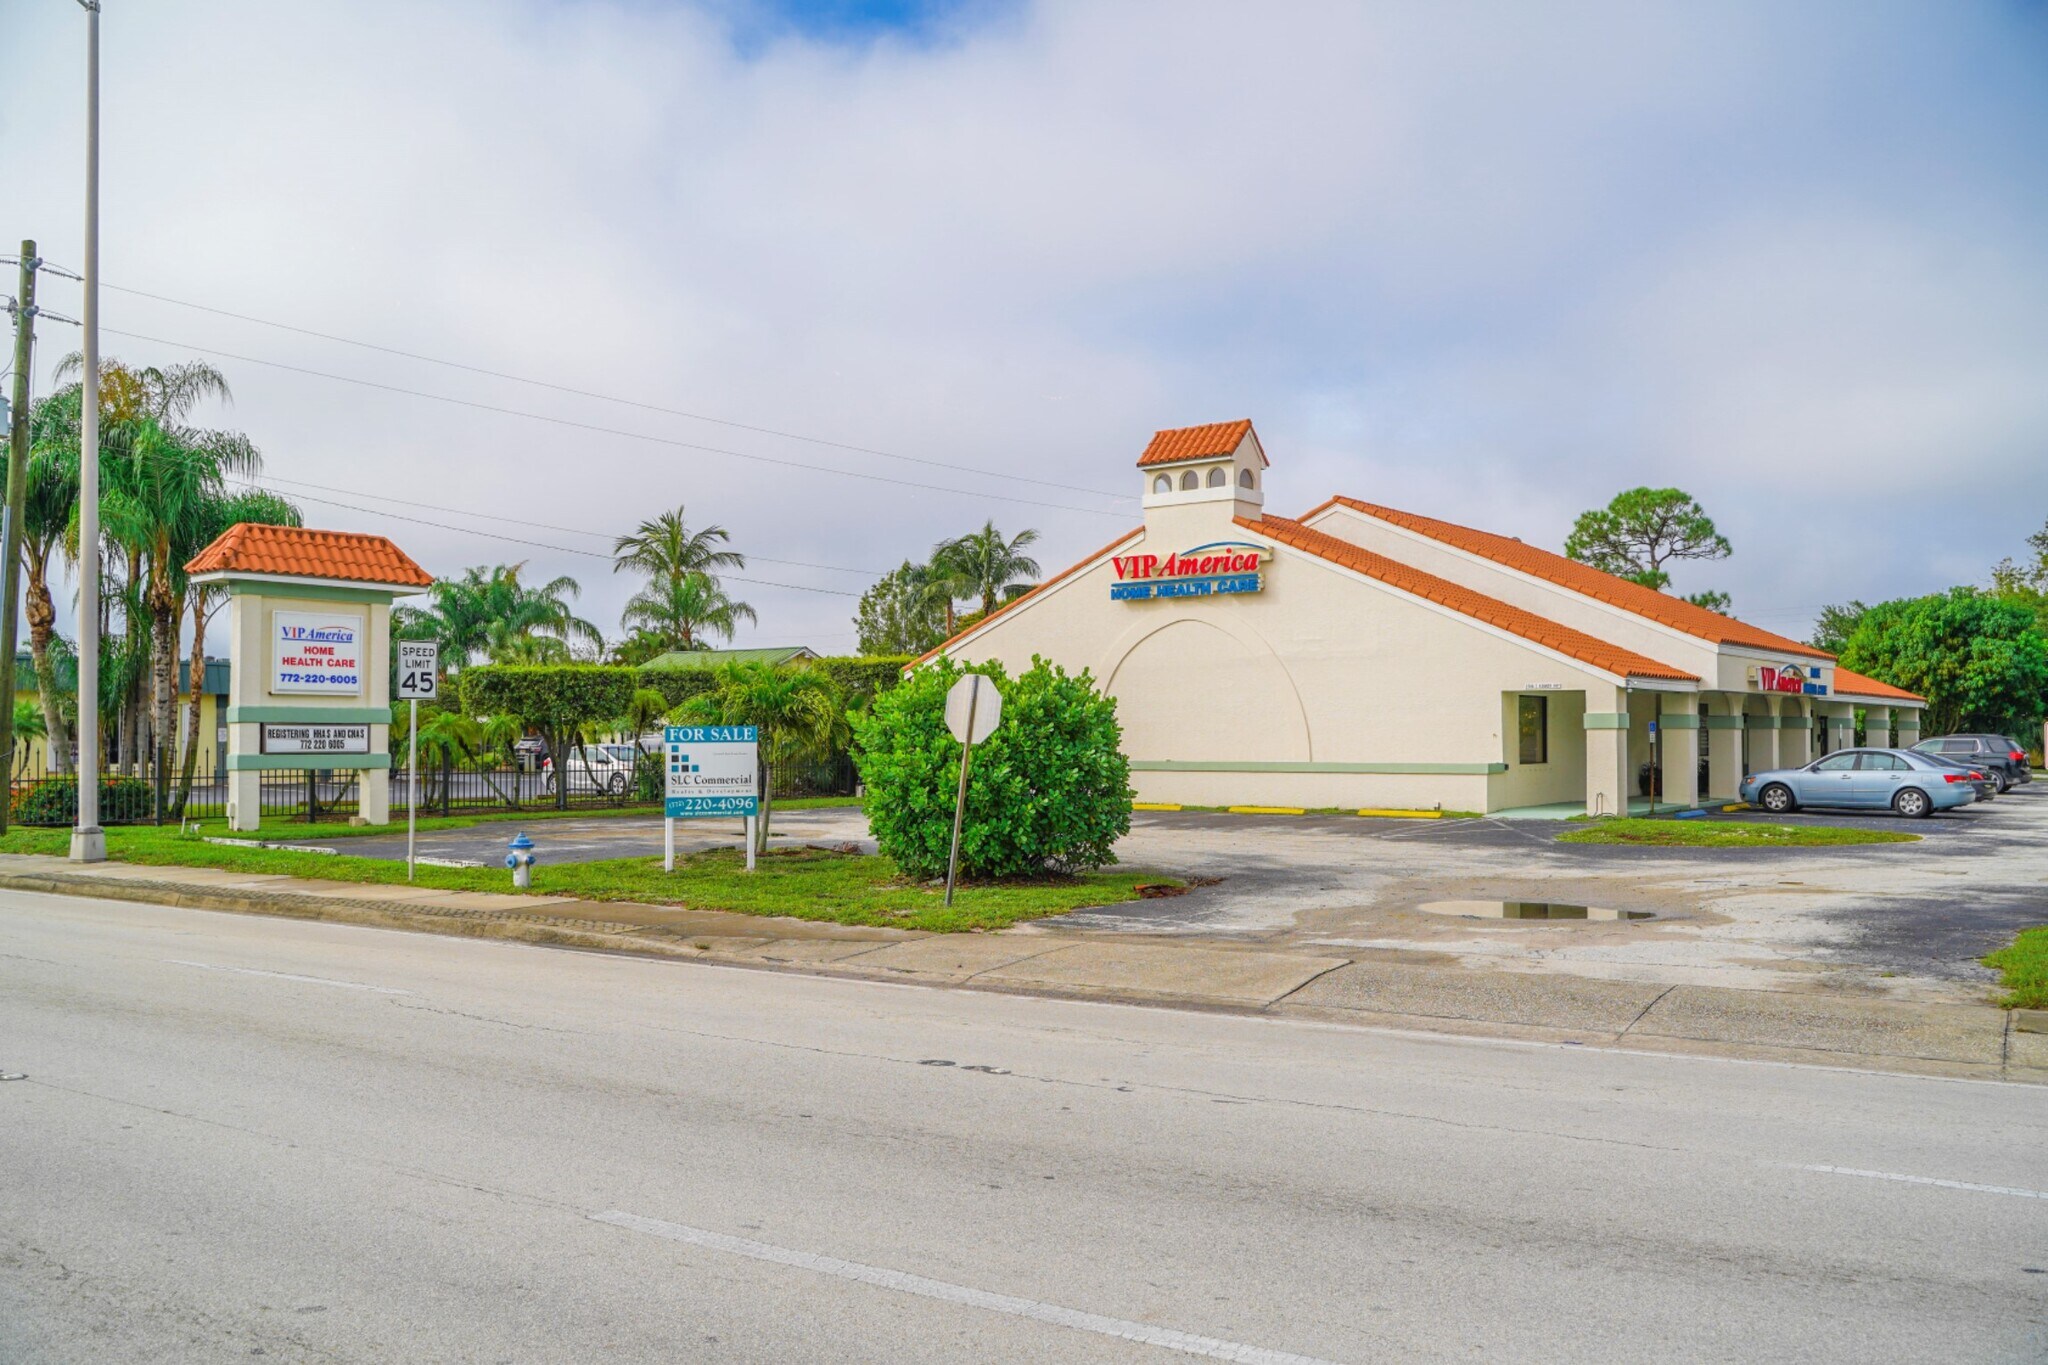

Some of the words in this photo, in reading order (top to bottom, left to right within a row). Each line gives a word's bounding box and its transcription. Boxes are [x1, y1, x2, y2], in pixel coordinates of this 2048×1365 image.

[1112, 554, 1158, 580] VIP
[1157, 548, 1260, 577] America
[1111, 586, 1152, 600] HOME
[1156, 582, 1212, 598] HEALTH
[1217, 579, 1260, 593] CARE
[282, 626, 306, 639] VIP
[305, 628, 353, 641] America
[303, 646, 335, 656] HOME
[402, 646, 435, 657] SPEED
[282, 657, 323, 667] HEALTH
[327, 658, 356, 668] CARE
[405, 659, 431, 669] LIMIT
[280, 673, 358, 684] 772-220-6005
[401, 671, 434, 693] 45
[267, 729, 310, 739] REGISTERING
[333, 729, 346, 739] AND
[669, 728, 705, 741] FOR
[710, 727, 754, 741] SALE
[300, 740, 312, 749] 772
[313, 740, 326, 749] 220
[328, 740, 345, 749] 6005
[671, 774, 691, 785] SLC
[694, 773, 752, 785] Commercial
[684, 797, 754, 810] 220-4096
